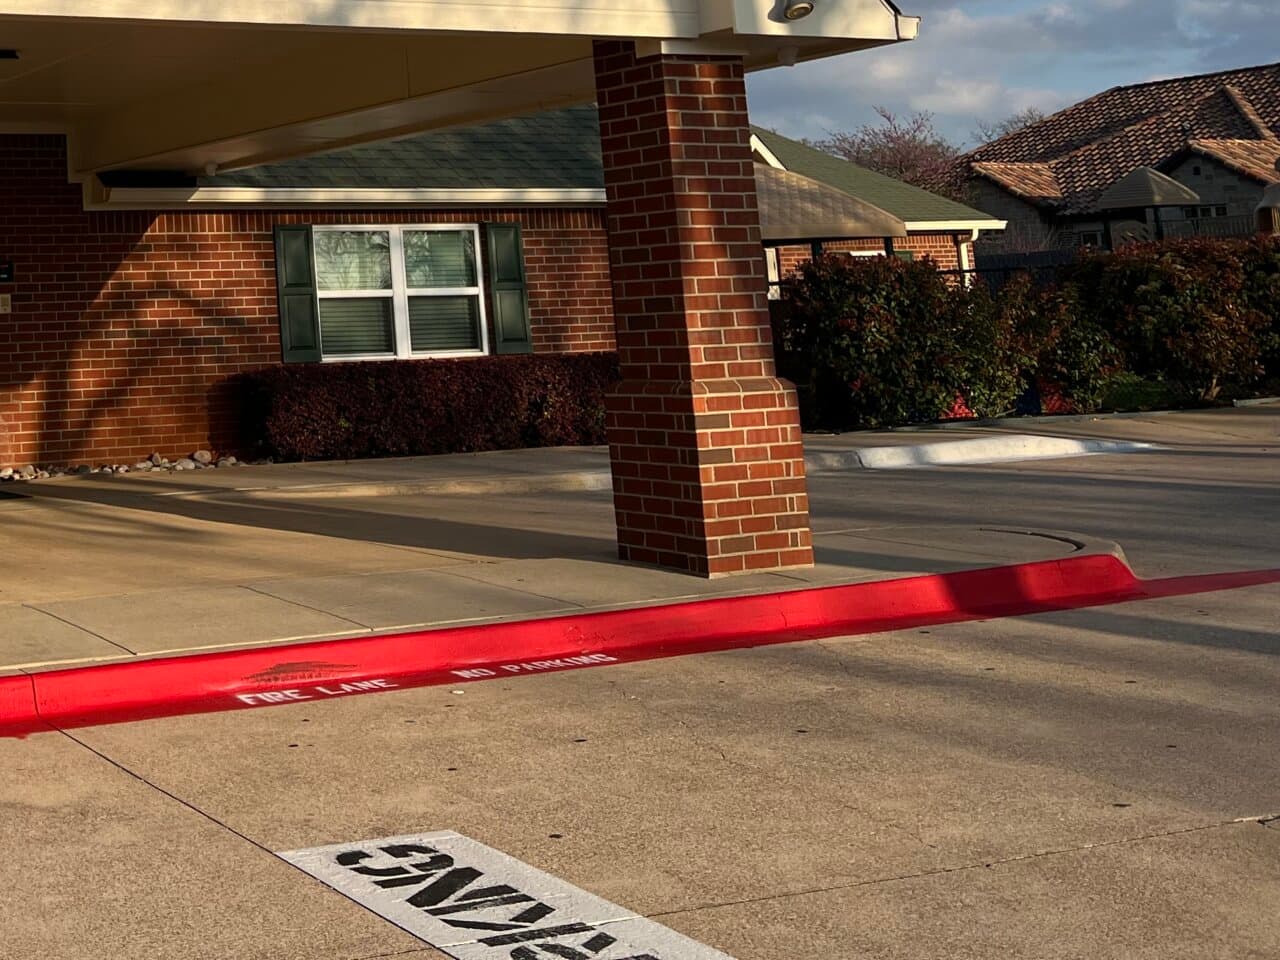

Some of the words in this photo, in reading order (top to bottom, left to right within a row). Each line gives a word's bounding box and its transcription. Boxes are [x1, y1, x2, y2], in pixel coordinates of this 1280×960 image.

[236, 689, 312, 705] FIRE
[314, 679, 399, 696] LANE
[450, 668, 496, 679] NO
[500, 653, 618, 673] PARKING
